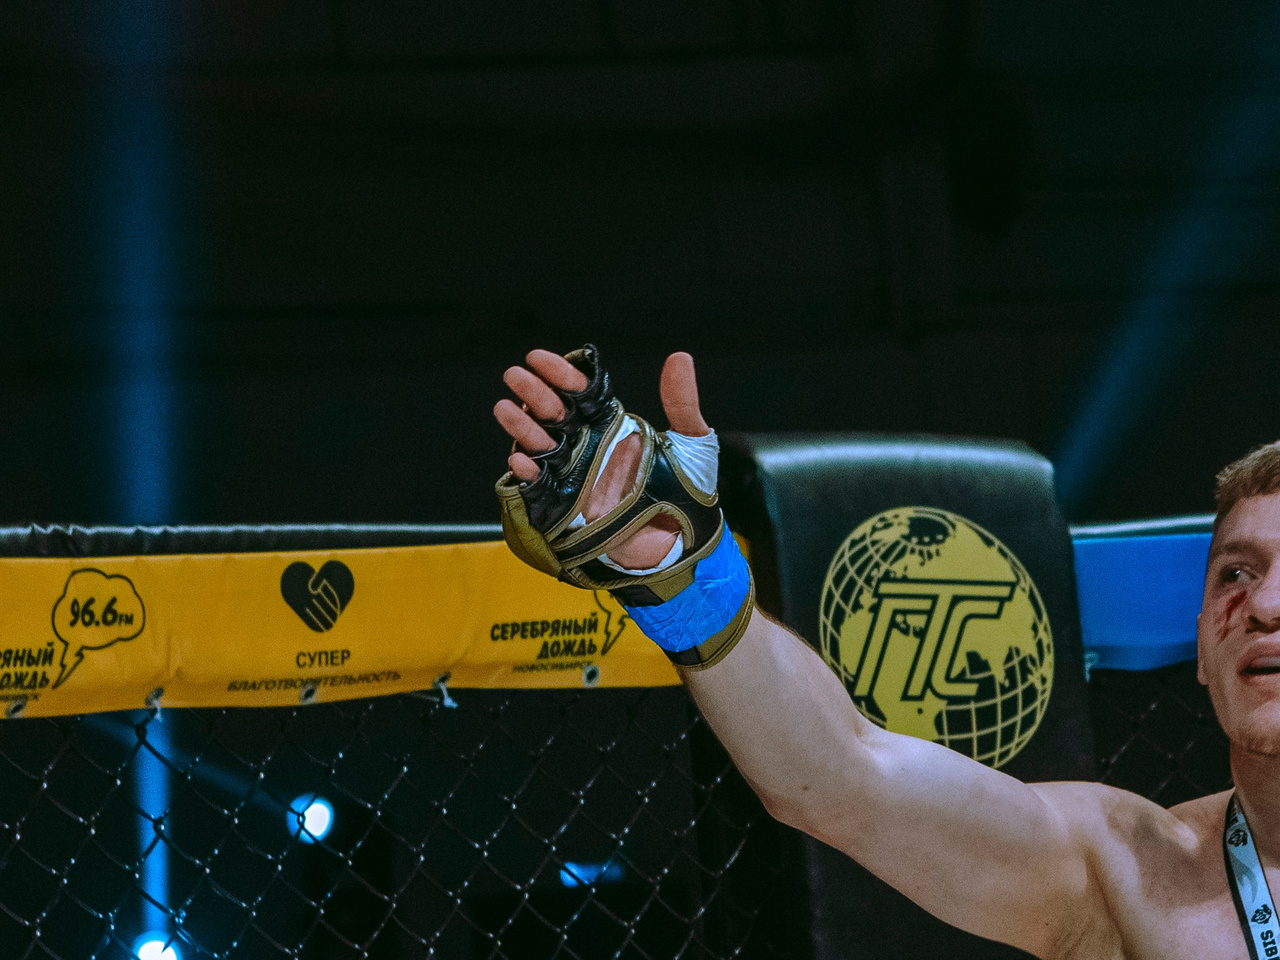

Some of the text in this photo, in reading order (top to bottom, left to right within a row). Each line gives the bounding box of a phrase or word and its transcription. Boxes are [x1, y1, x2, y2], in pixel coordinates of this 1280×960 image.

[490, 612, 599, 641] СЕРЕБРЯНЫЙ
[0, 642, 54, 669] ЯНЫЙ
[296, 649, 351, 668] СУПЕР
[537, 639, 598, 660] ДОЖДЬ
[227, 669, 402, 692] БЛАГОТВОРИТЕЛЬНОСТЬ
